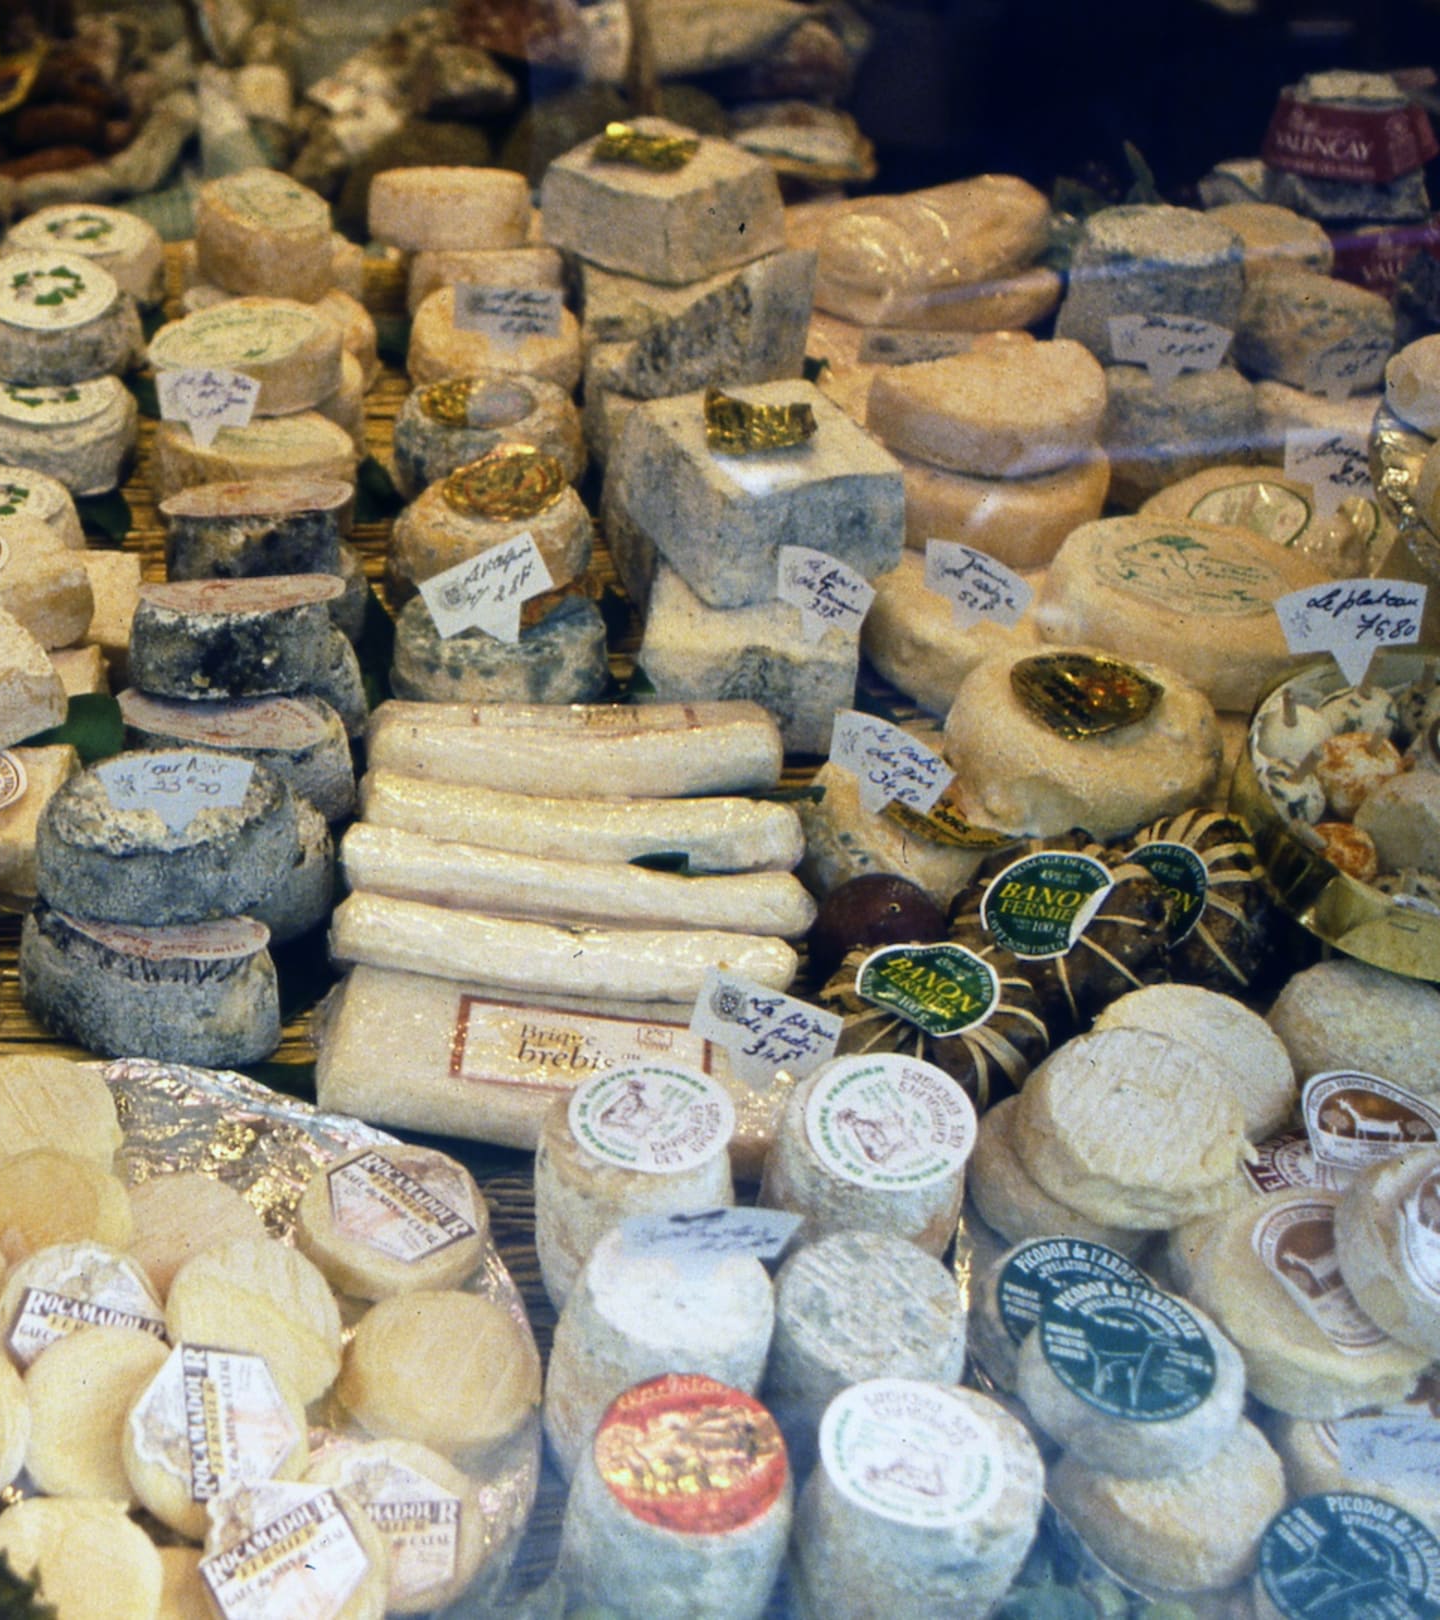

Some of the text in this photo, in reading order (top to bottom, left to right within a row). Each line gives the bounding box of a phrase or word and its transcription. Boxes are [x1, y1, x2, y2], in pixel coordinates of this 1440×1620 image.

[1000, 899, 1078, 923] FERMIE
[886, 957, 982, 1013] BANON
[516, 1039, 617, 1070] brebis
[360, 1154, 470, 1237] ROCAMADOUR
[1013, 1241, 1069, 1274] PICODON
[1053, 1280, 1109, 1312] PICODON
[184, 1347, 218, 1501] ROCAMADOUR
[1325, 1495, 1397, 1523] PICODON
[209, 1490, 337, 1586] ROCAMADOUR
